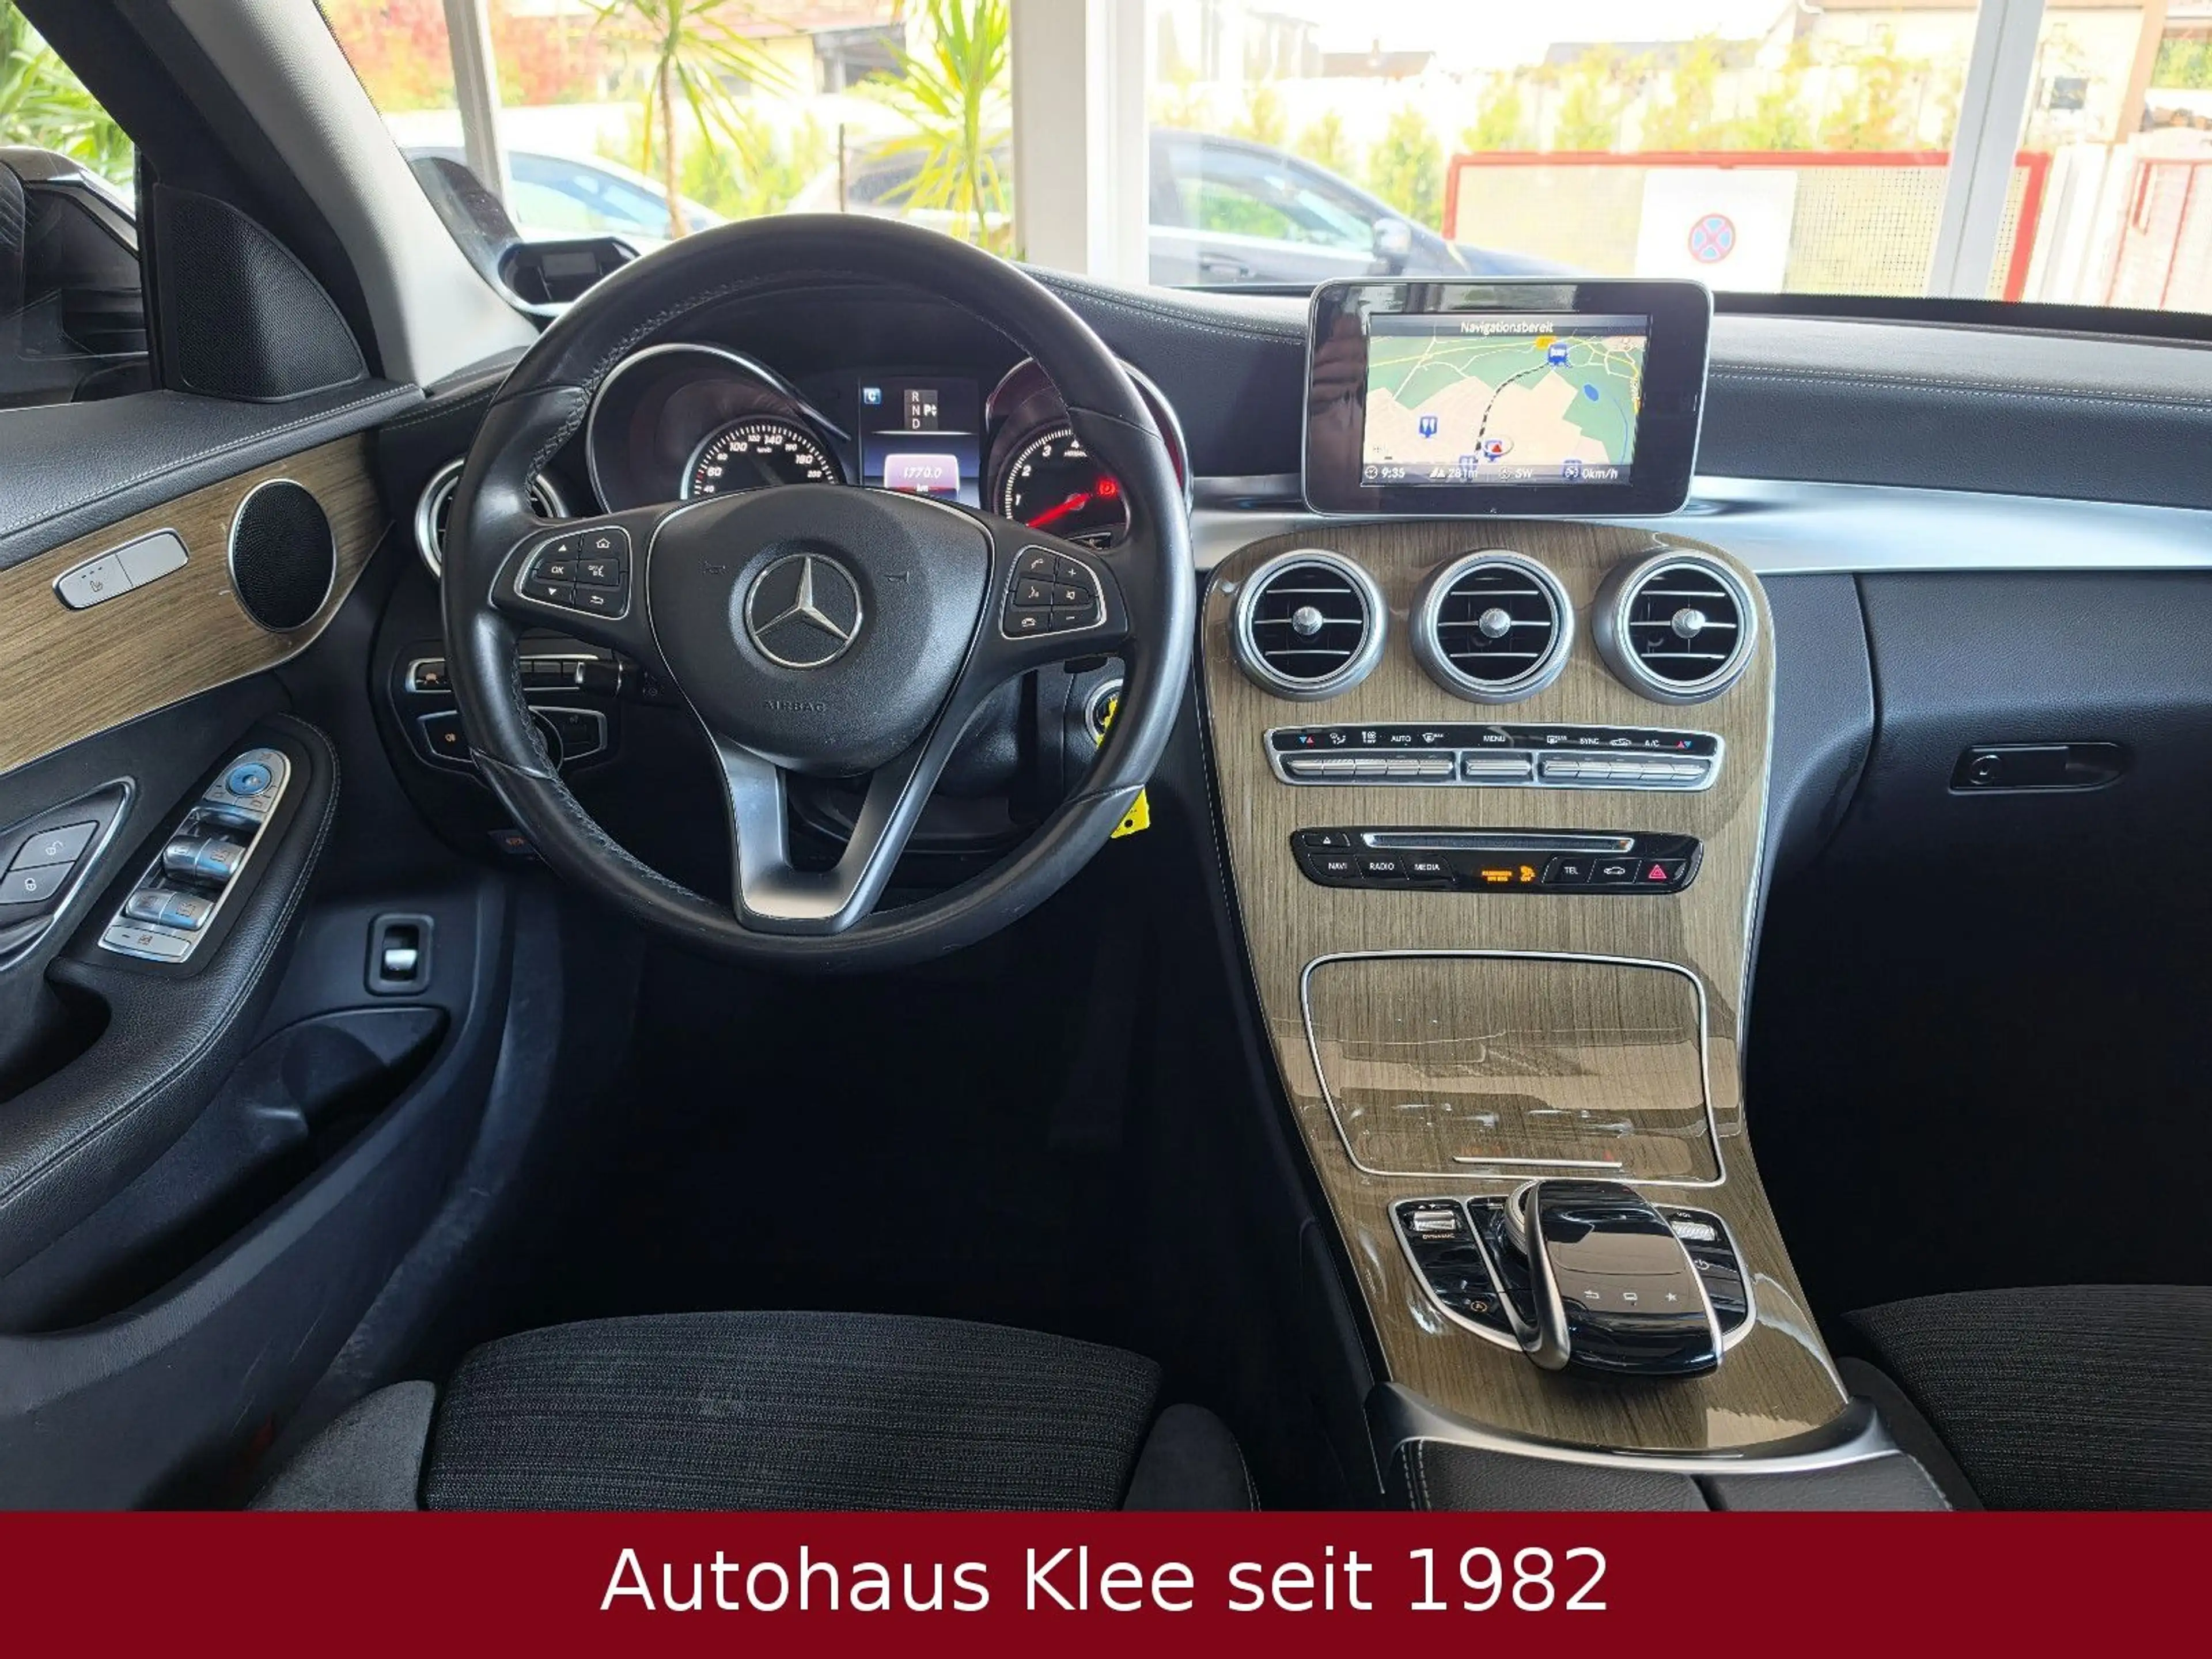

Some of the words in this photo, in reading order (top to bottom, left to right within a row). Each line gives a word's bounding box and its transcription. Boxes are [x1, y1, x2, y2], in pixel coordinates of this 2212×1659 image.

[1460, 320, 1554, 335] Navigationsbereit
[911, 391, 919, 402] R
[912, 405, 921, 416] N
[923, 404, 931, 416] P
[912, 418, 921, 429] D
[764, 434, 782, 445] 140
[729, 441, 748, 452] 100
[1042, 444, 1052, 457] 3
[795, 454, 813, 464] 180
[707, 467, 723, 477] 60
[1021, 464, 1032, 476] 2
[1382, 468, 1406, 479] 9:35
[1515, 468, 1533, 479] SW
[1582, 468, 1619, 479] 0km/h
[703, 484, 715, 493] 40
[1016, 494, 1022, 506] 1
[551, 566, 564, 574] OK
[763, 700, 827, 711] AIRBAG
[1391, 734, 1411, 743] AUTO
[1580, 737, 1600, 745] SYNC
[1644, 738, 1660, 747] A/C
[1328, 862, 1348, 870] NAVI
[1369, 862, 1395, 870] RADIO
[1414, 863, 1441, 872] MEDIA
[1563, 866, 1580, 875] TEL
